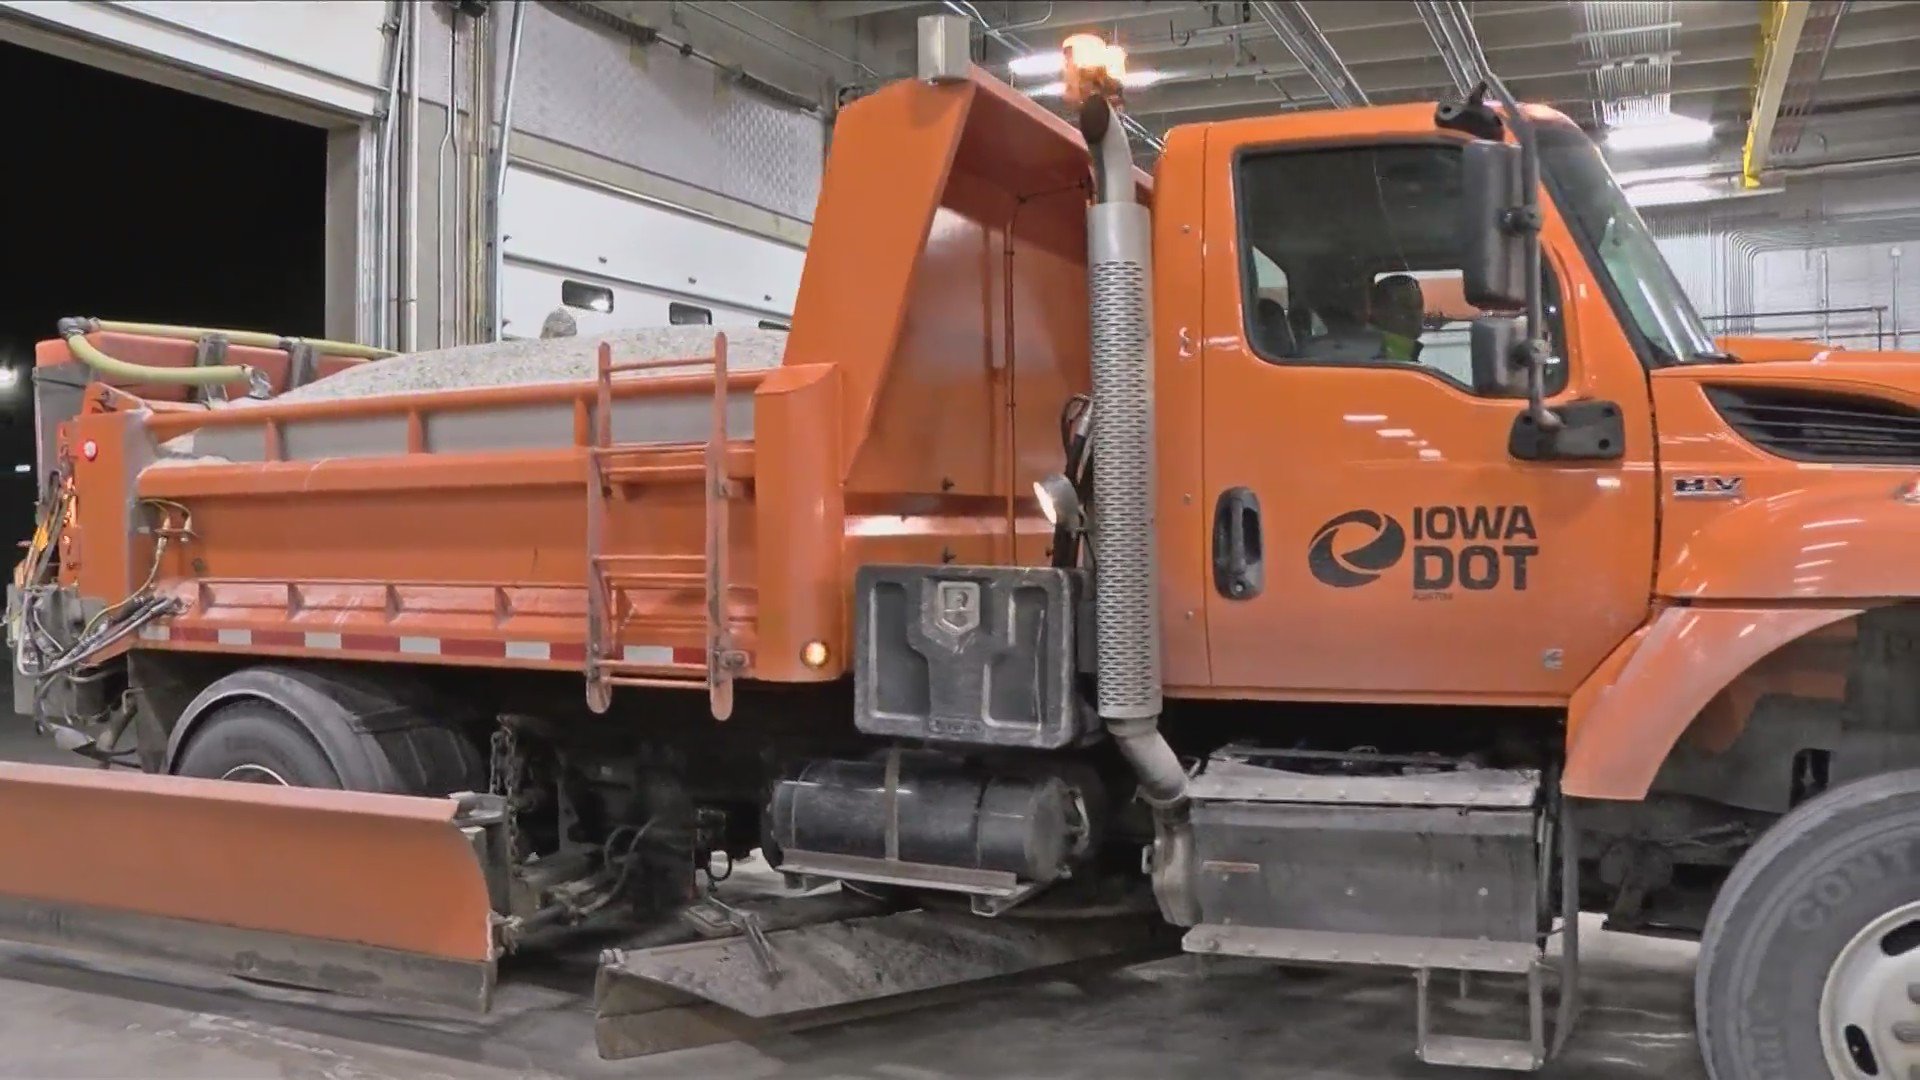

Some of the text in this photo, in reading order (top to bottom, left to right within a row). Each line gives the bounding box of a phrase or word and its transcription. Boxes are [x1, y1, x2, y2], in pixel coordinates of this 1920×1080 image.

[1673, 476, 1742, 495] HV
[1413, 505, 1537, 540] IOWA
[1413, 545, 1539, 590] DOT
